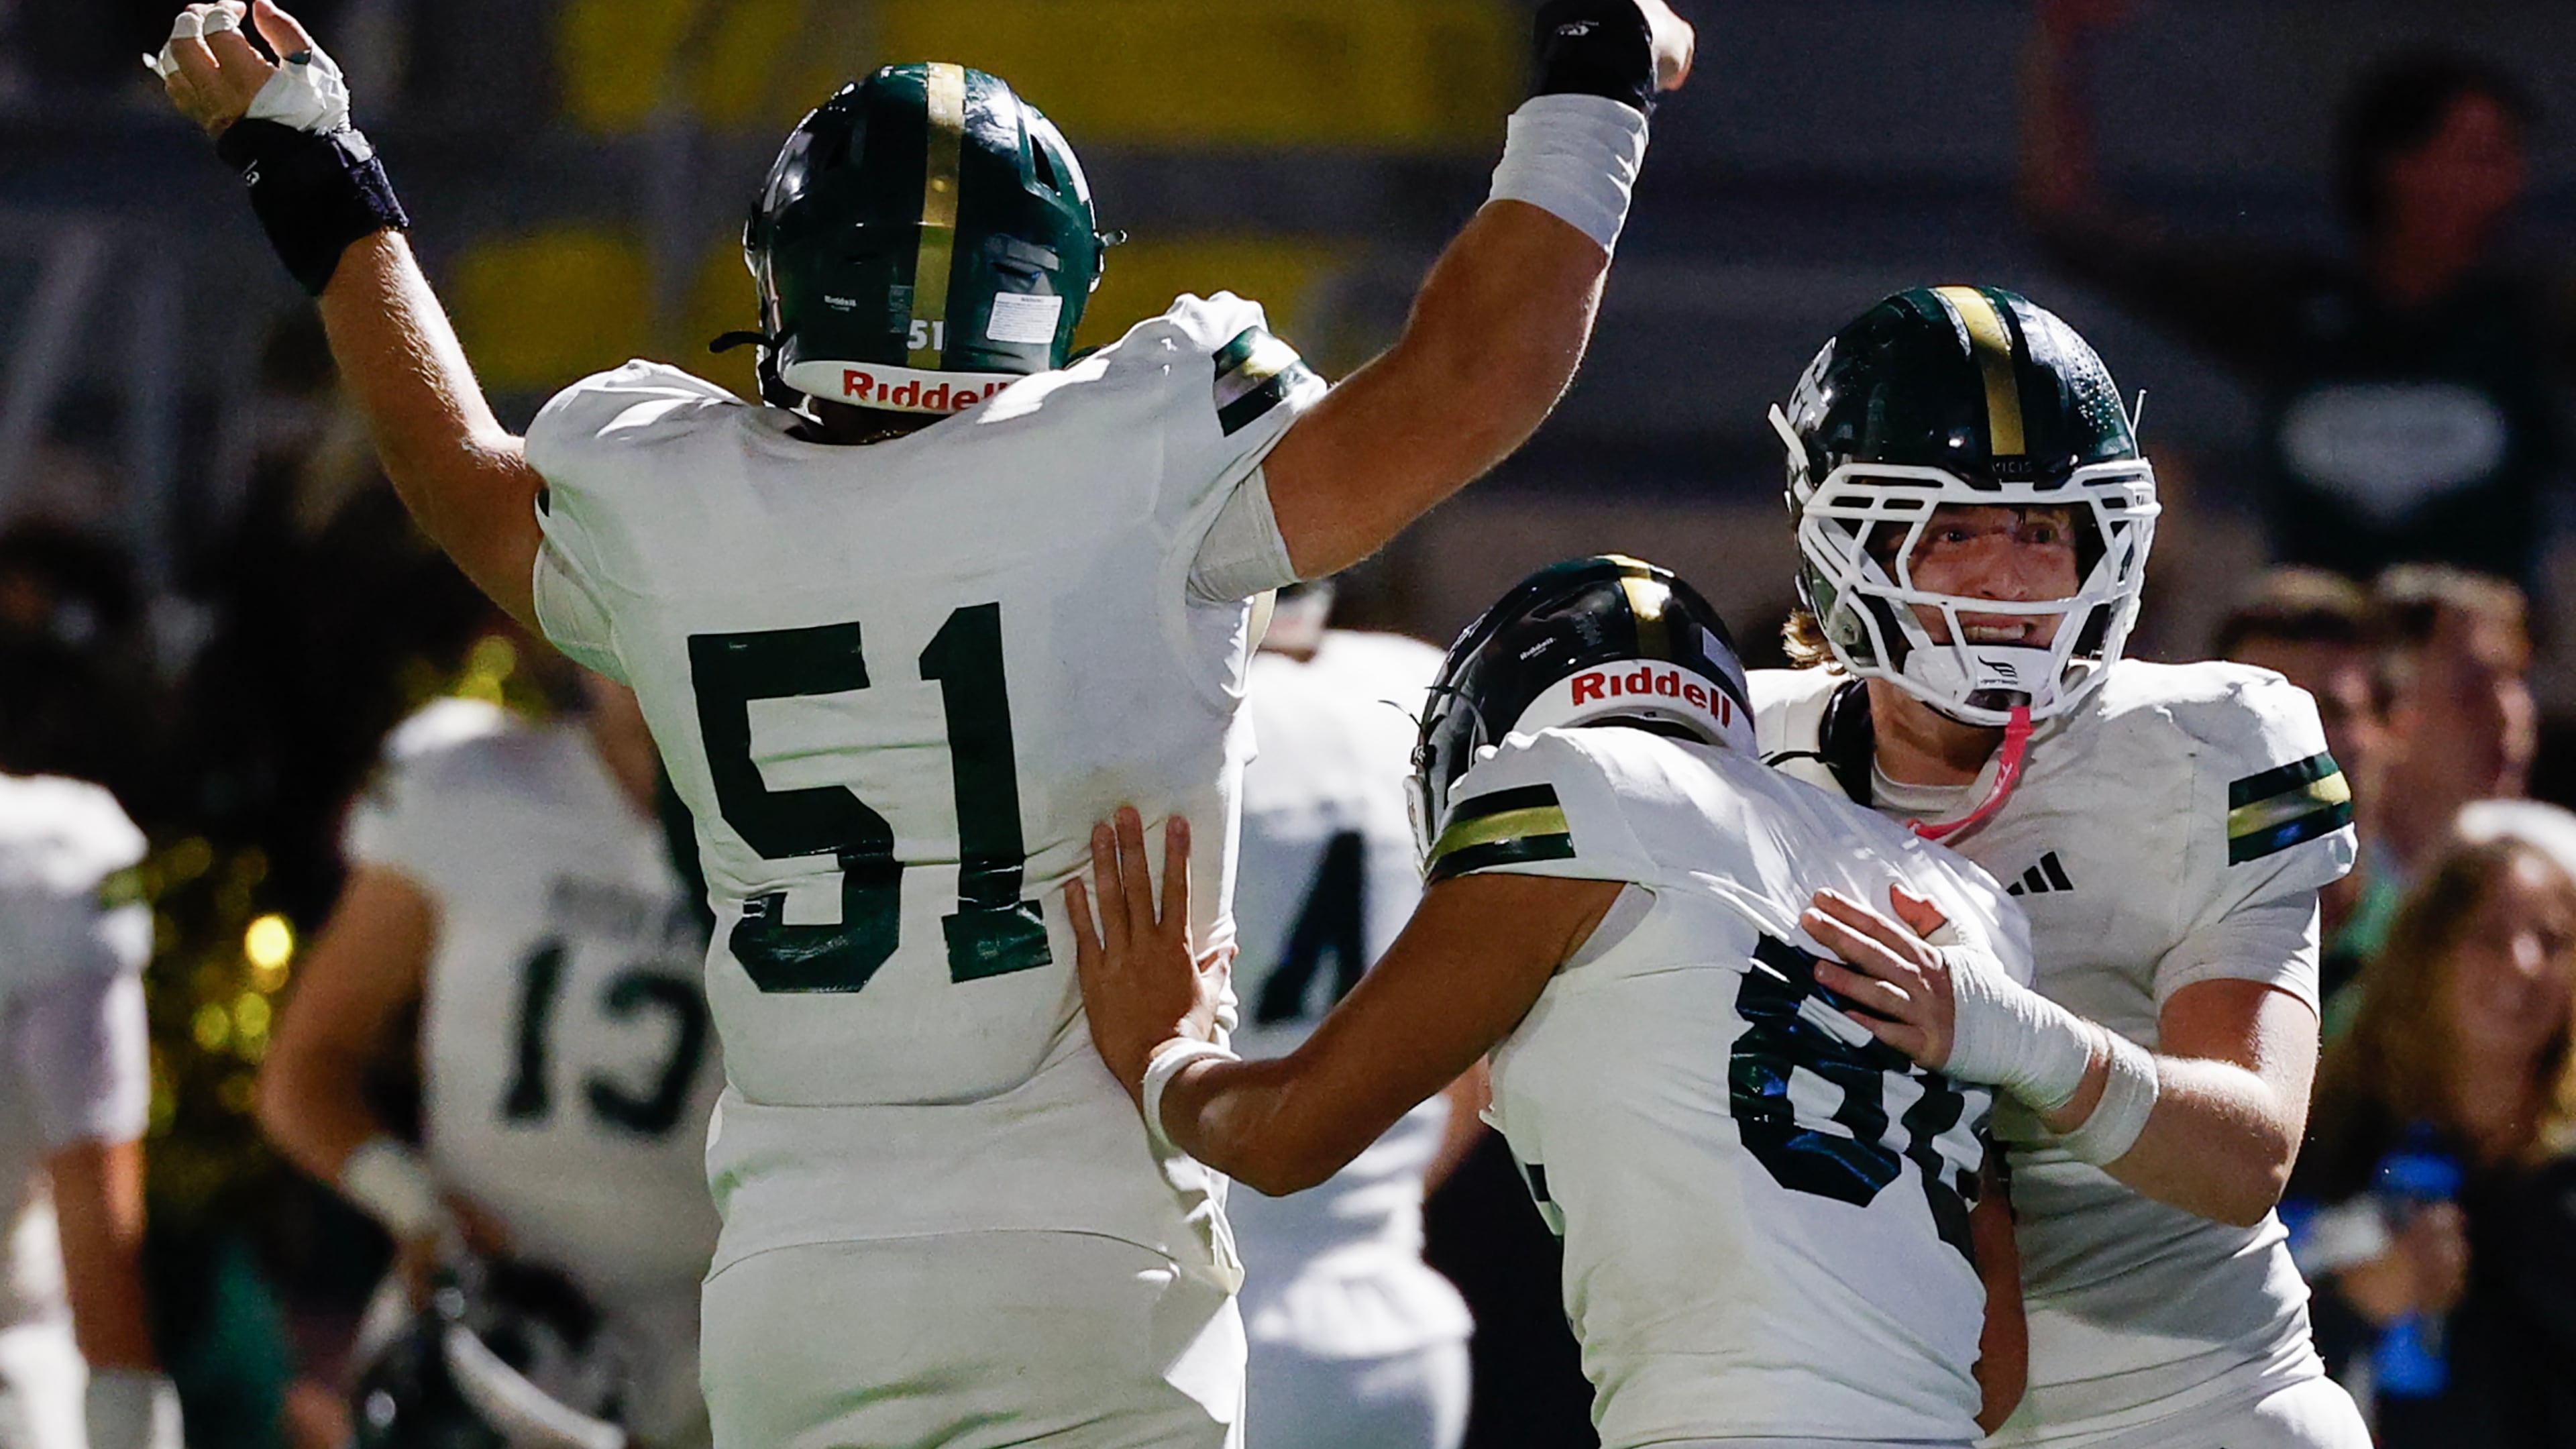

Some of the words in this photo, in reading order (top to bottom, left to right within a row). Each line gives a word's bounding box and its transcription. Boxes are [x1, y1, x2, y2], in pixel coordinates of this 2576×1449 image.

[906, 319, 944, 350] 51
[1571, 666, 1731, 729] Riddell
[687, 601, 1053, 994] 51
